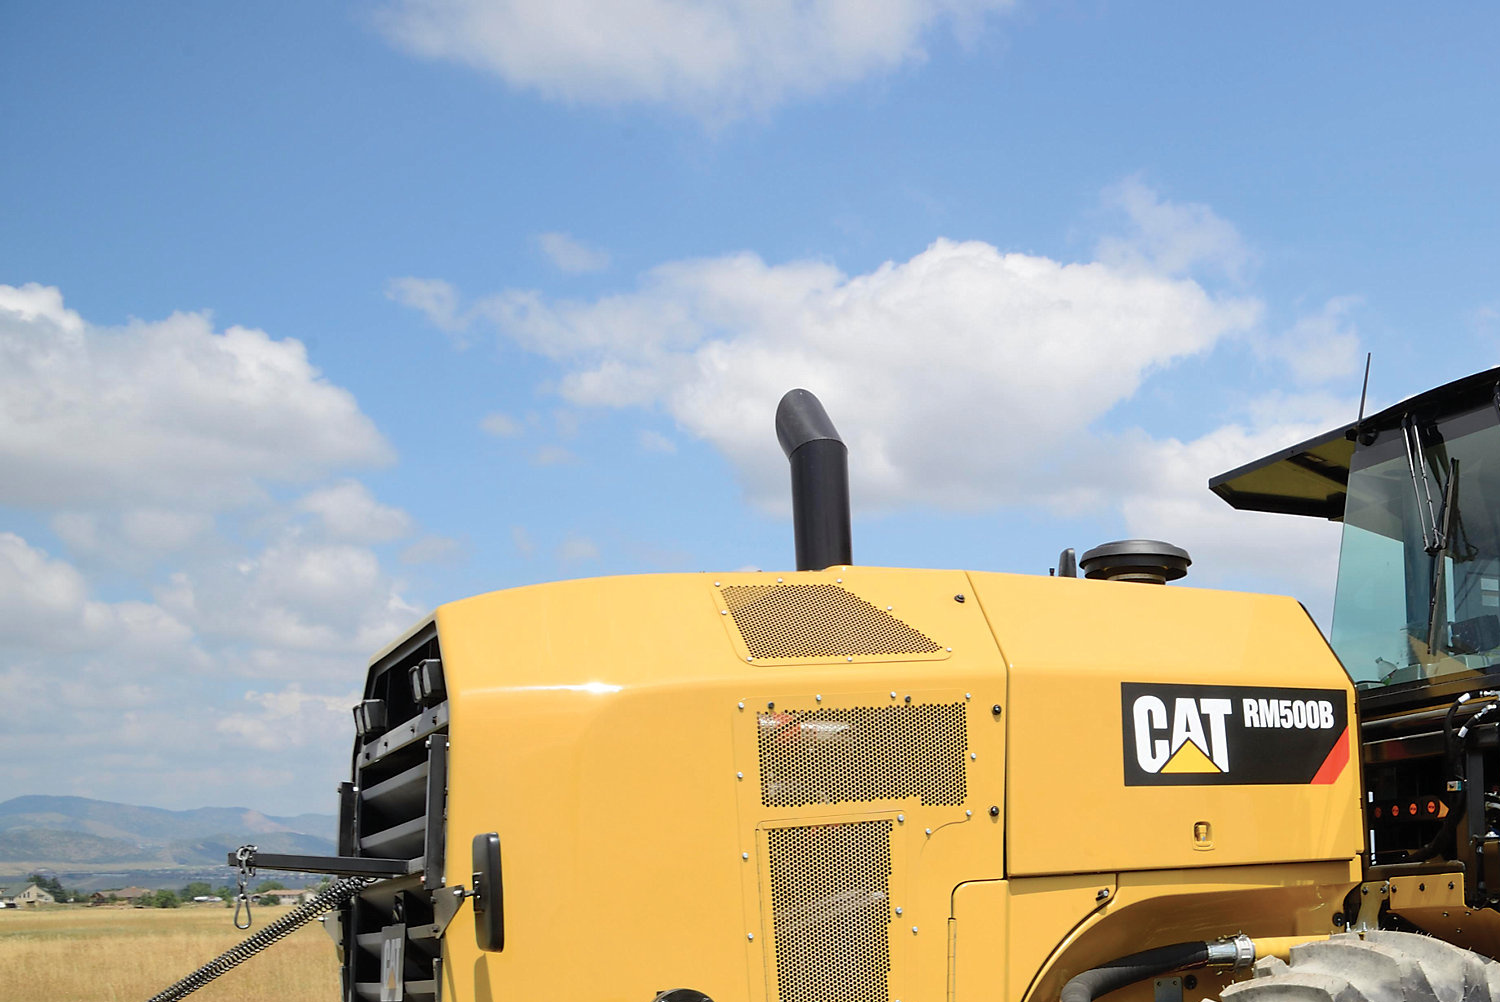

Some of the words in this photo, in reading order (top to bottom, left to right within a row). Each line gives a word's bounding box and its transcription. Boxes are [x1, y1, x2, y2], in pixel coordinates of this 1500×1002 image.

[1133, 695, 1232, 773] CAT
[1242, 698, 1334, 729] RM500B
[384, 938, 402, 989] CAT
